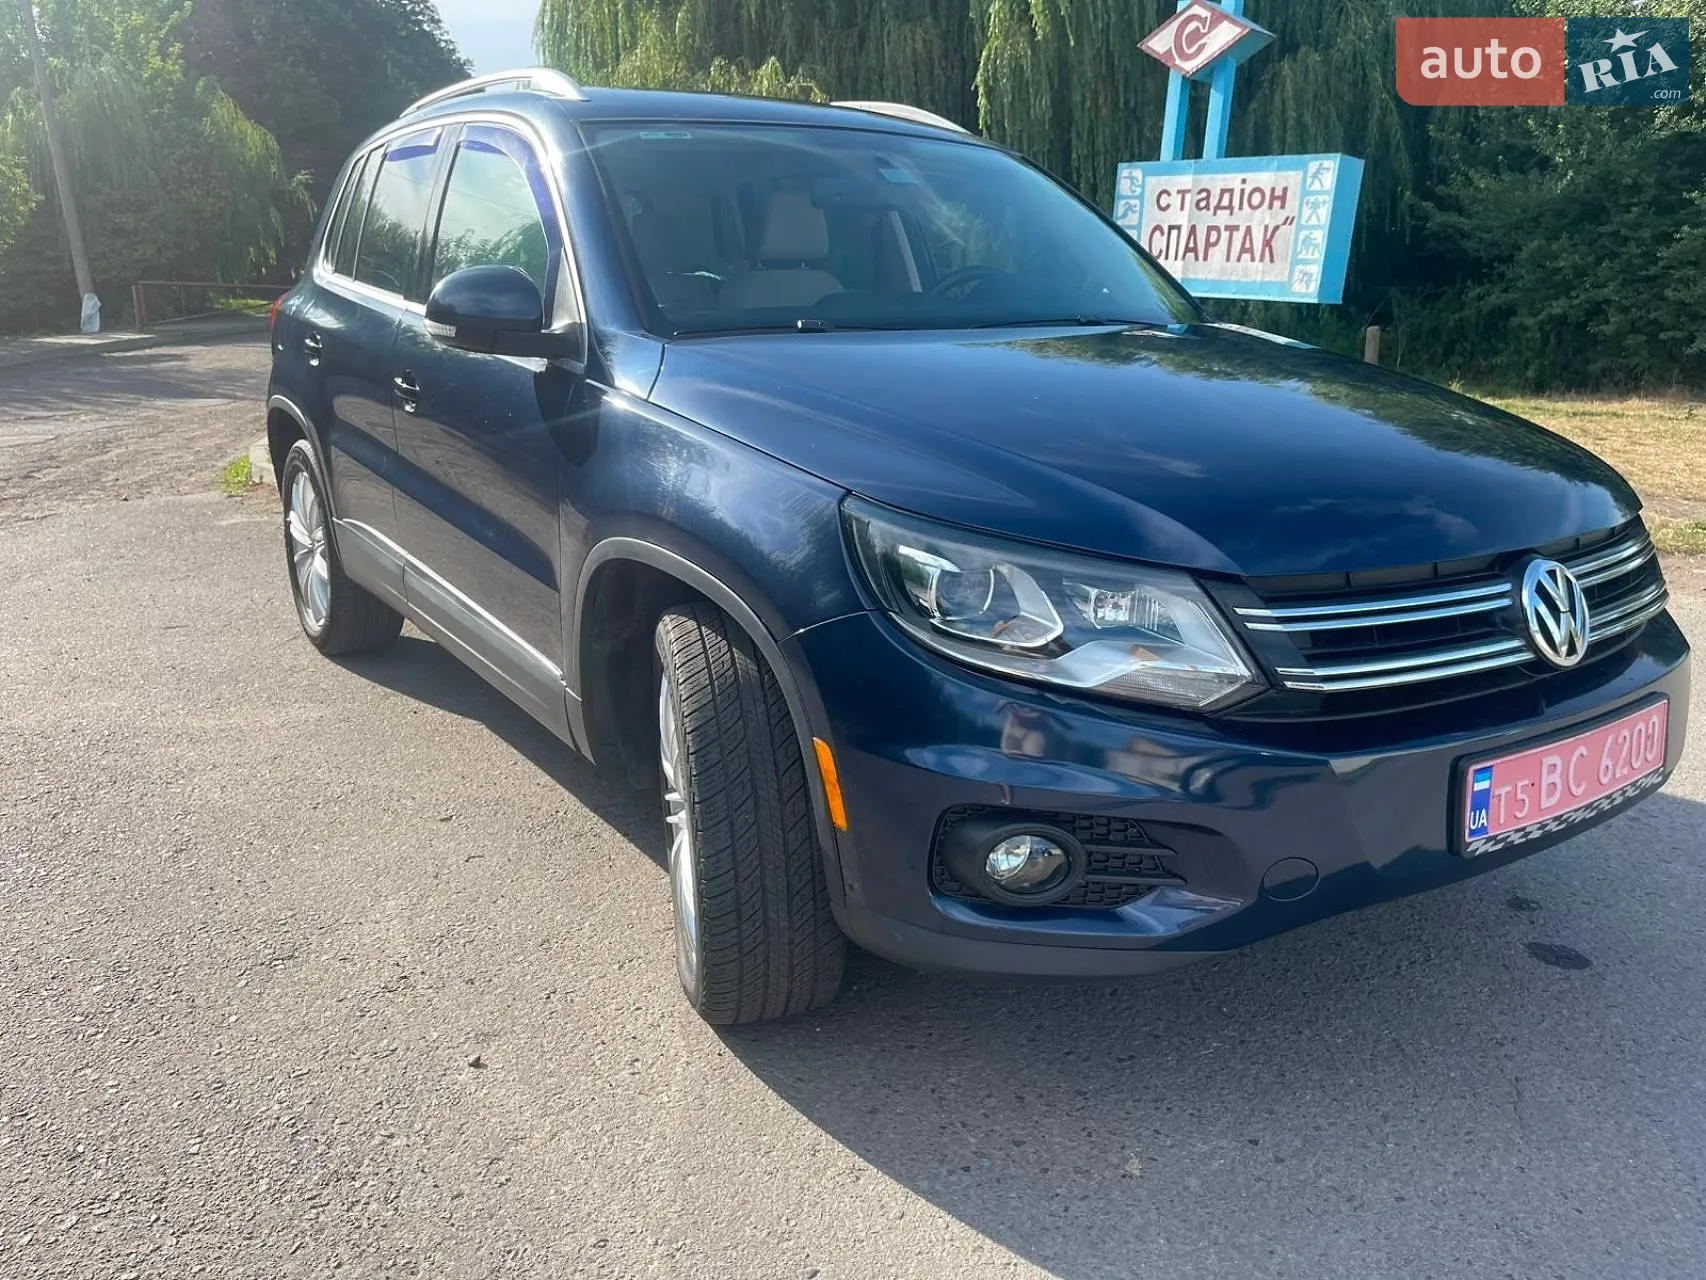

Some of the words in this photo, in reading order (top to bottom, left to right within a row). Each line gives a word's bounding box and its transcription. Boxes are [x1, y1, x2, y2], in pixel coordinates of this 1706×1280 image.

[1156, 178, 1288, 216] стадіон
[1493, 779, 1530, 825] T5
[1540, 746, 1588, 810] BC
[1597, 715, 1659, 785] 6200
[1469, 811, 1488, 830] UA
